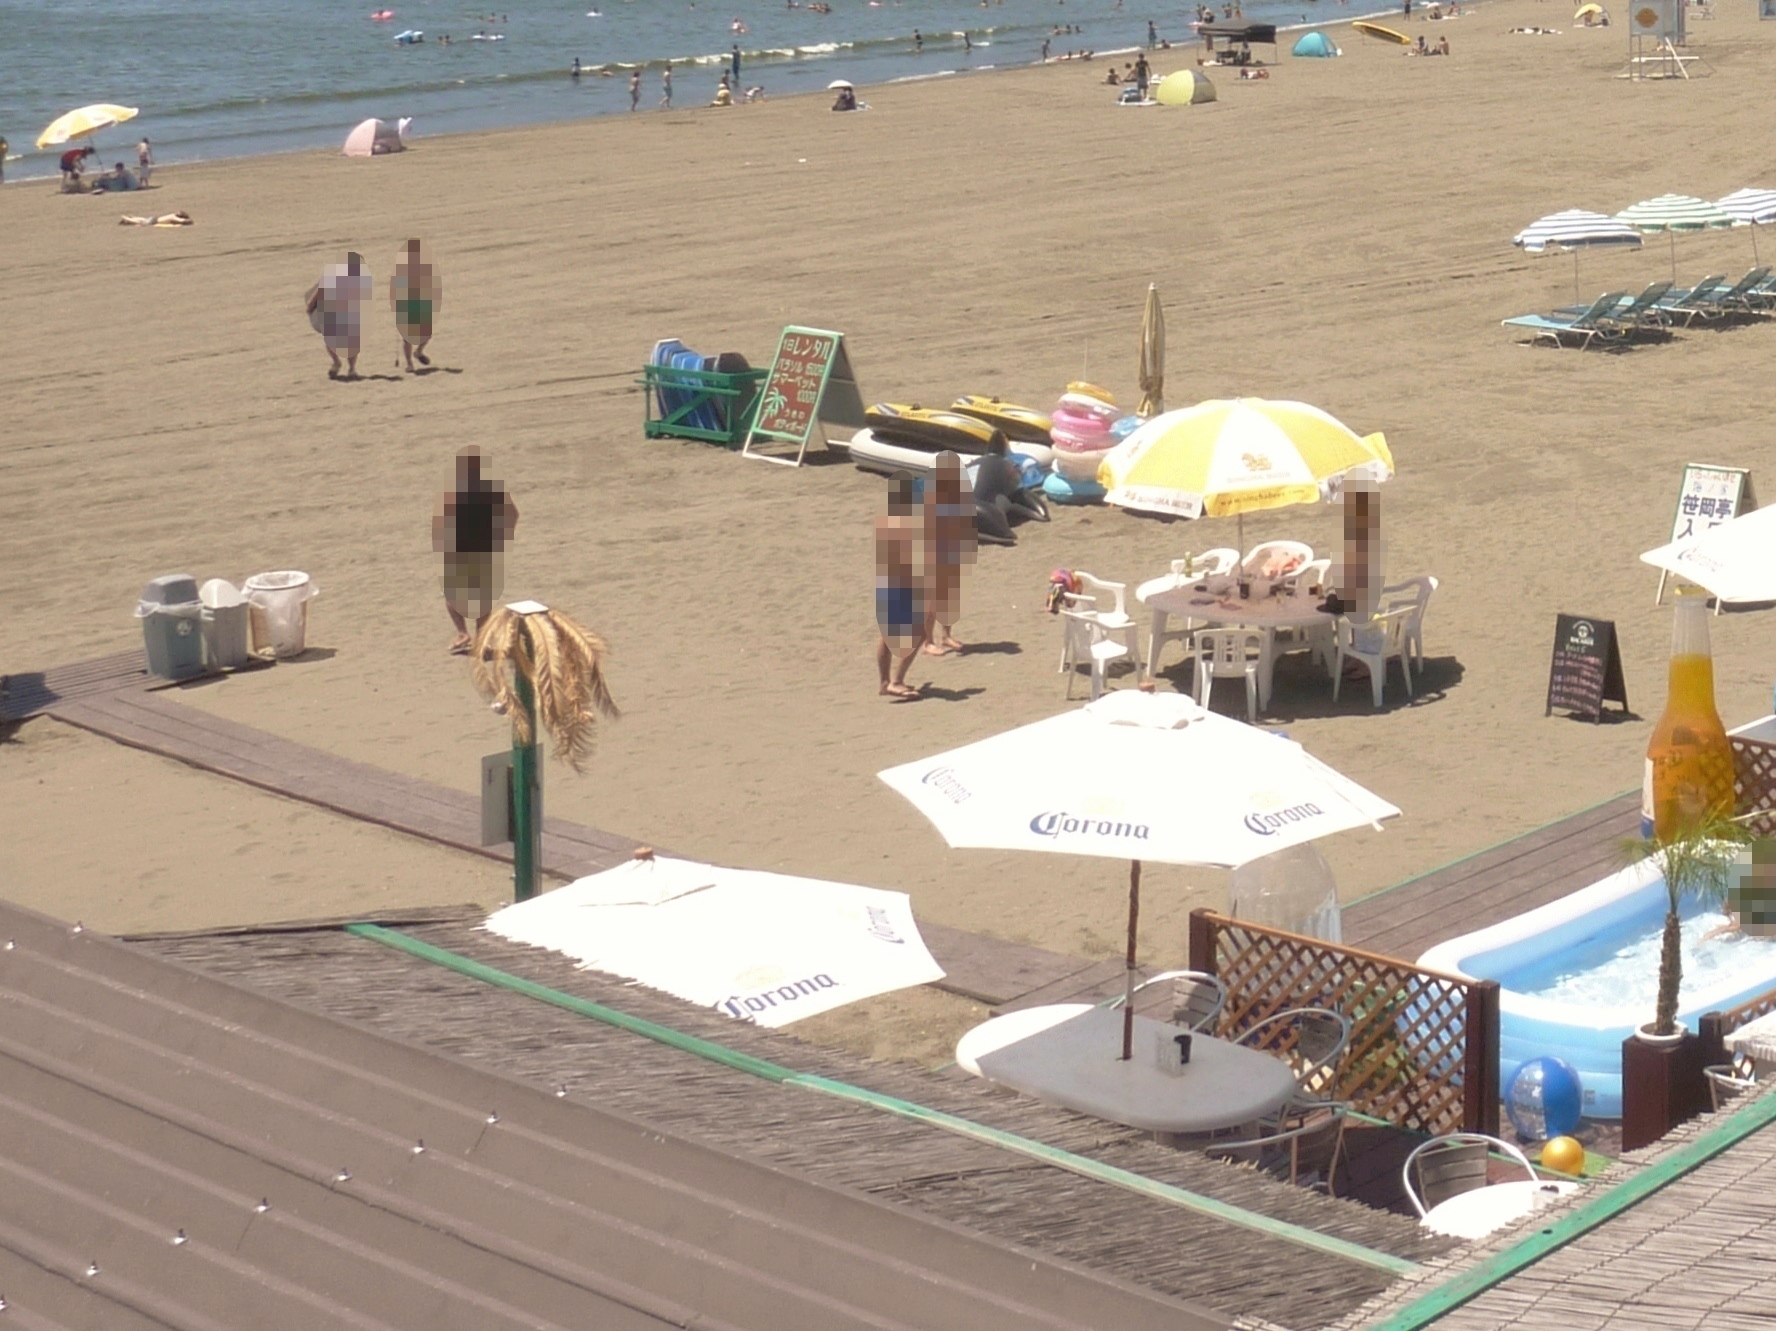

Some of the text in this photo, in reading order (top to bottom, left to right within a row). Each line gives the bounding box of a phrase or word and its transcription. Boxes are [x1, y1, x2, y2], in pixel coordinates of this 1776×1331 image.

[1682, 493, 1734, 519] 笹岡亭
[1030, 811, 1150, 841] Corona
[1244, 800, 1325, 837] Corona
